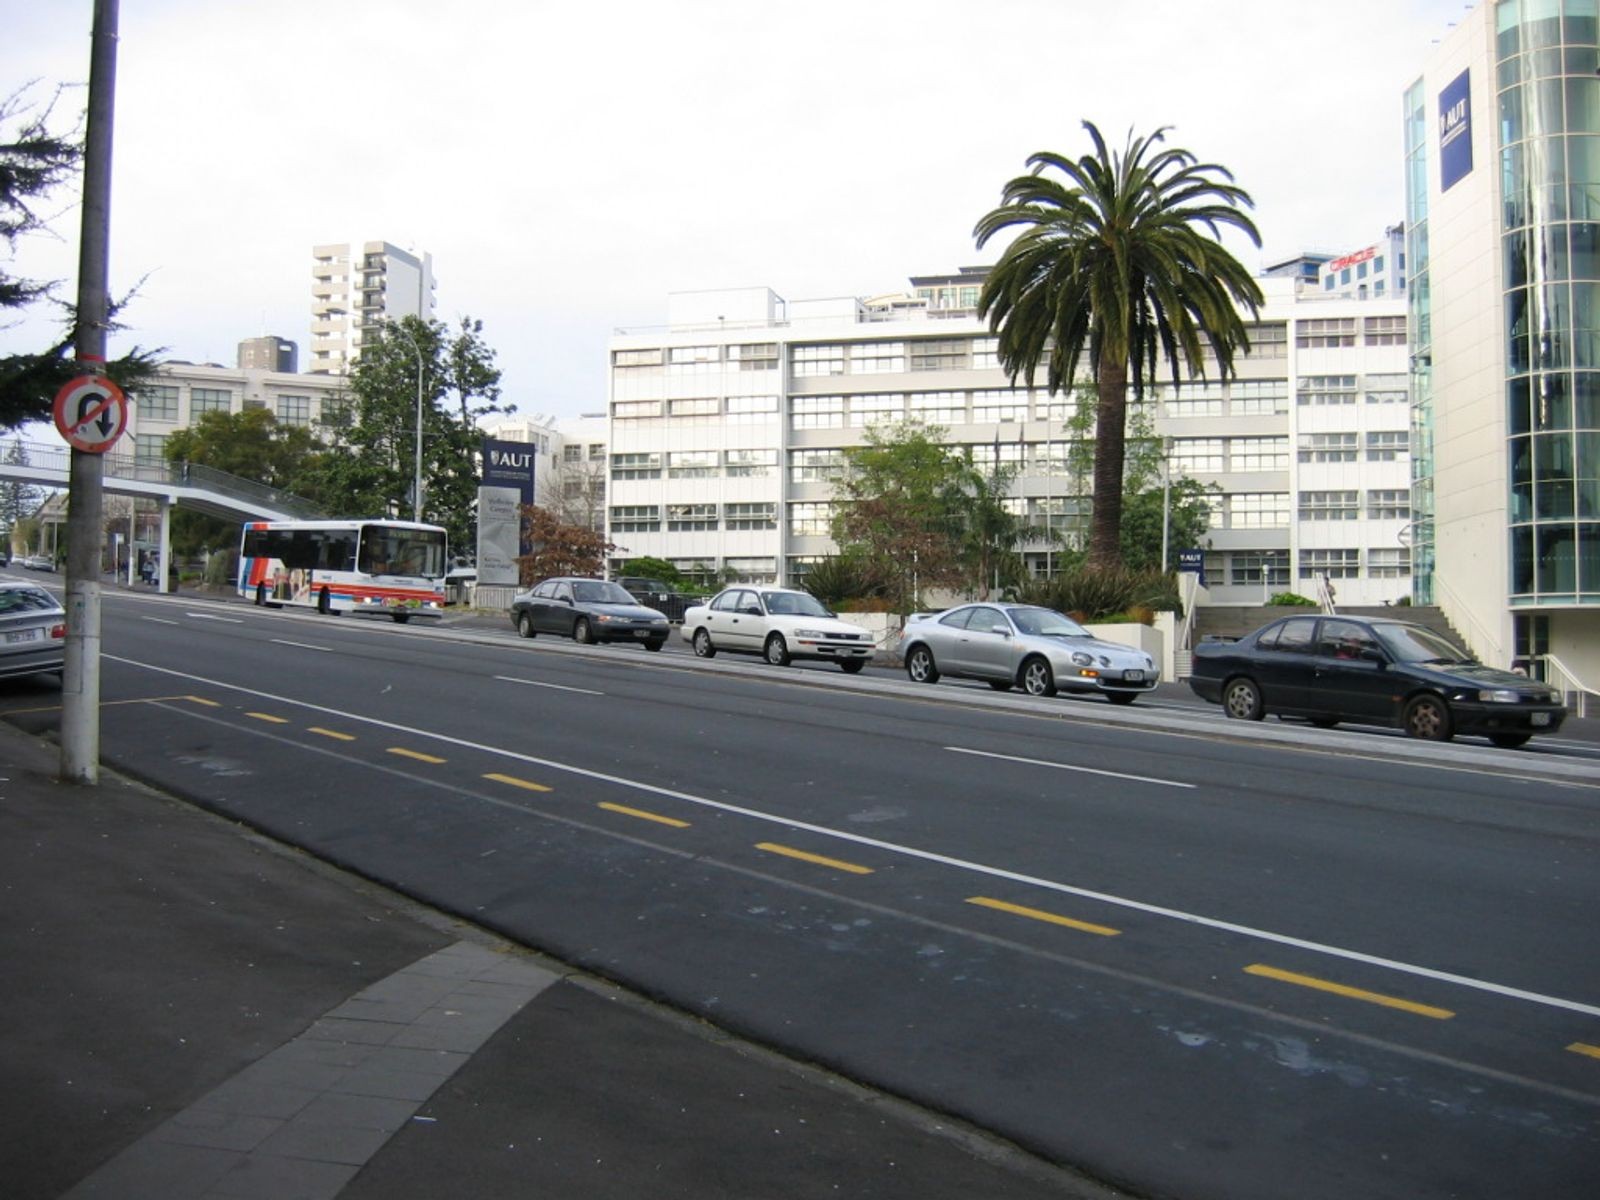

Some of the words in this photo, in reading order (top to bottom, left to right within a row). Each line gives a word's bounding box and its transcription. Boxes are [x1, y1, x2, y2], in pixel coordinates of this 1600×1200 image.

[1447, 98, 1466, 130] AUT
[1330, 246, 1376, 271] ORACLE
[500, 452, 532, 468] AUT
